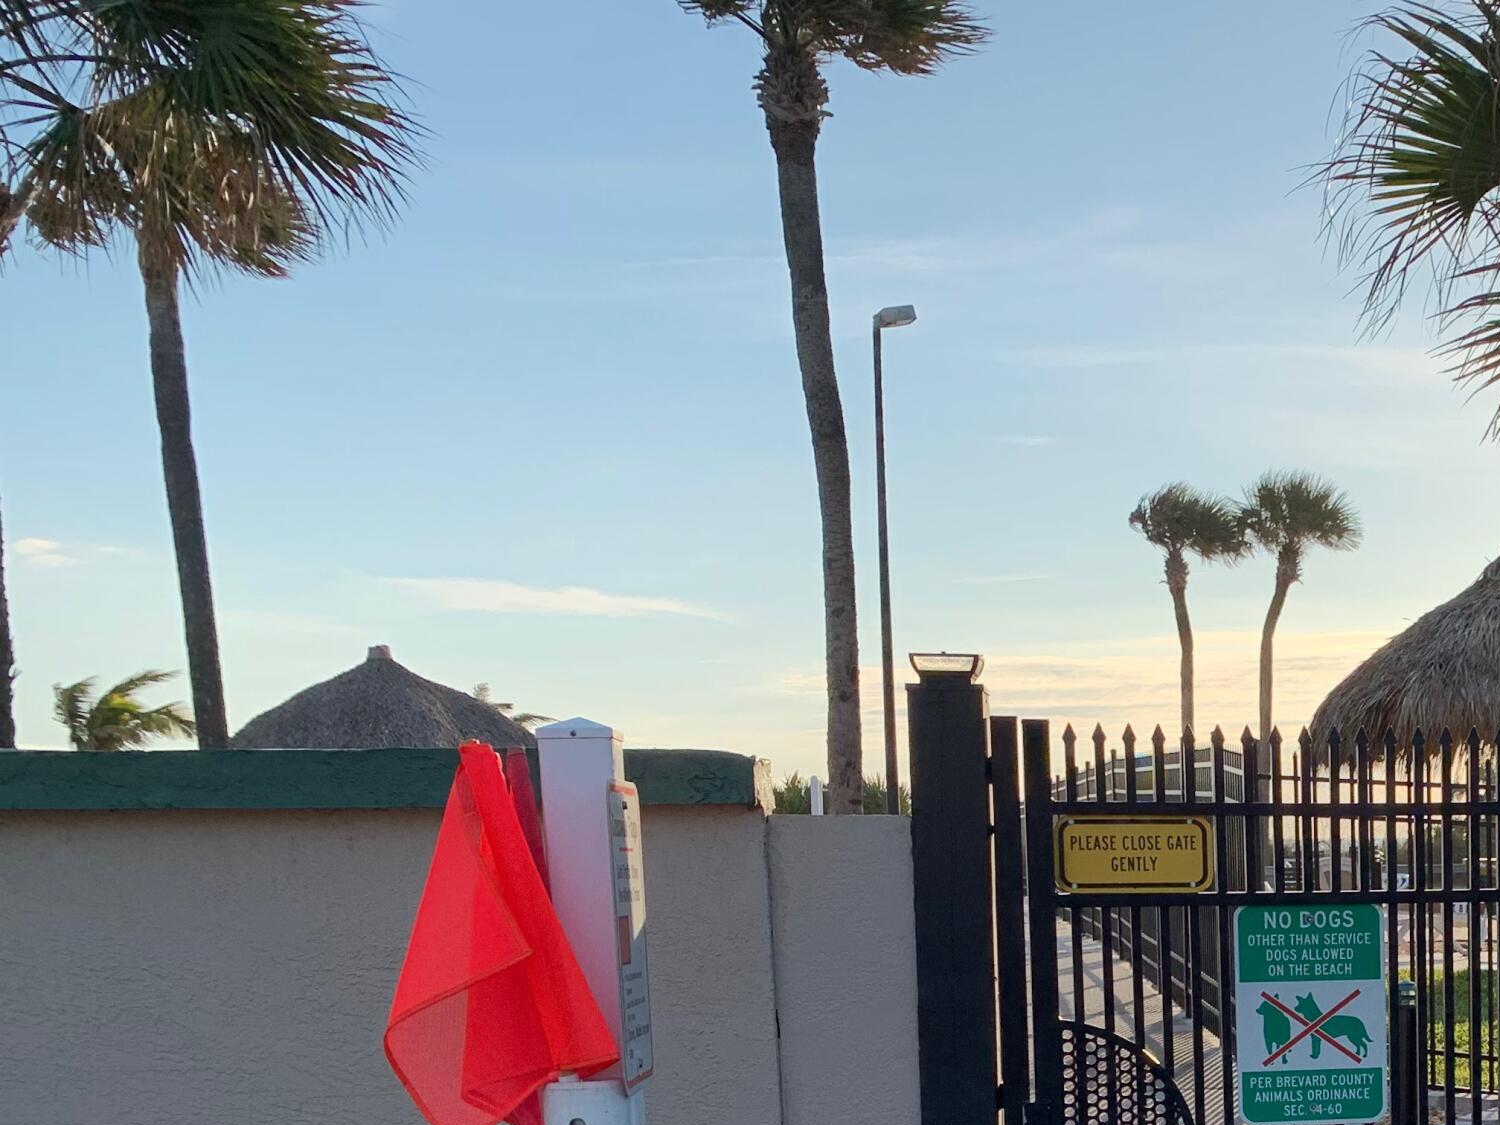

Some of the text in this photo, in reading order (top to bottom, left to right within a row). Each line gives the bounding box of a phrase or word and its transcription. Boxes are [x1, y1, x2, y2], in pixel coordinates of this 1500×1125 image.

[1070, 835, 1197, 850] PLEASE CLOSE GATE
[1111, 857, 1157, 872] GENTLY
[1264, 910, 1354, 929] NO DOGS
[1248, 932, 1371, 946] OTHER THAN SERVICE
[1266, 948, 1354, 961] DOGS ALLOWED
[1268, 963, 1352, 976] ON THE BEACH
[1250, 1073, 1375, 1088] PER BREVARD COUNTY
[1255, 1088, 1370, 1103] ANIMALS ORDINANCE
